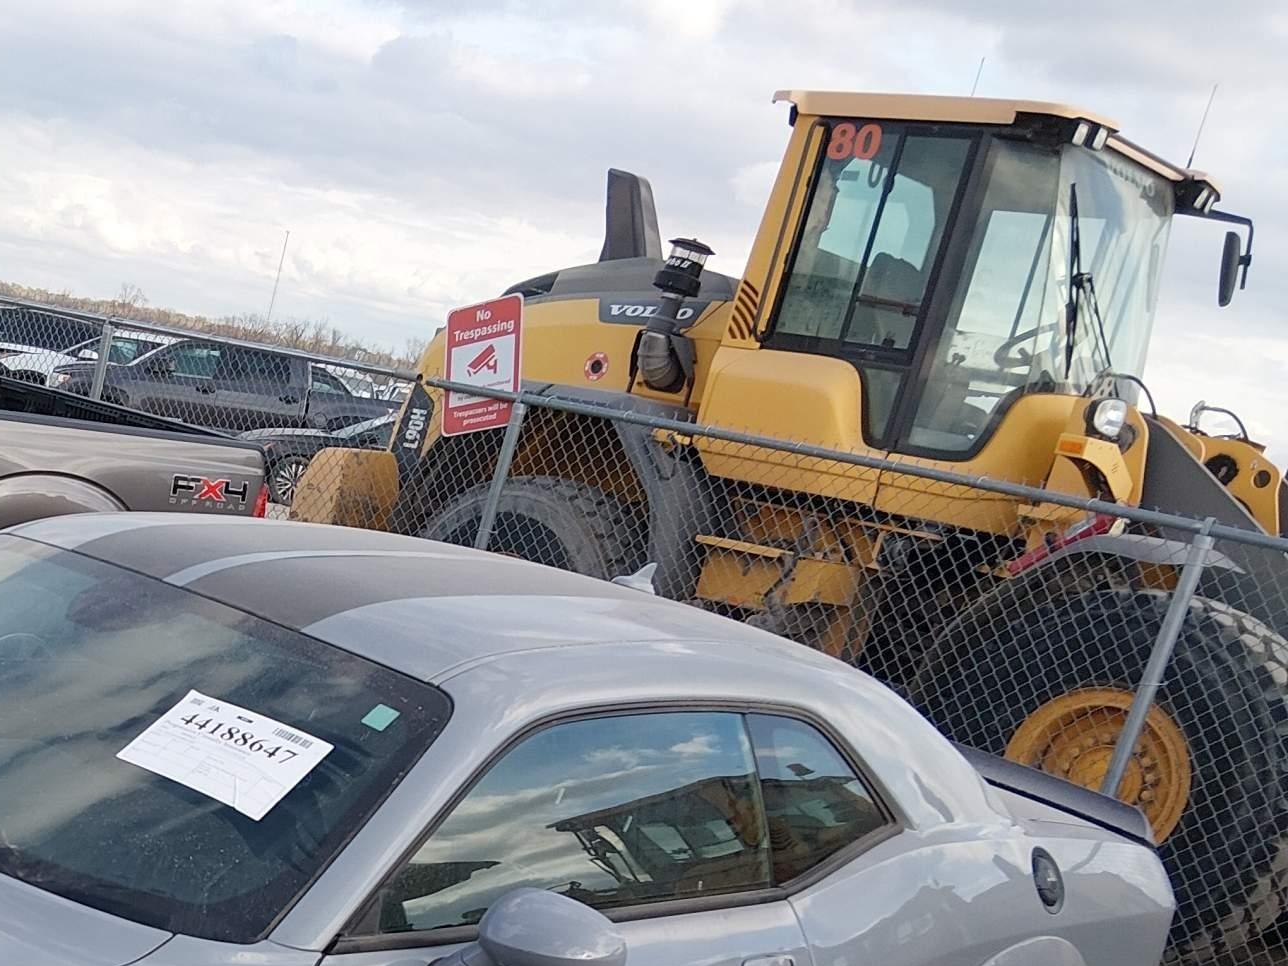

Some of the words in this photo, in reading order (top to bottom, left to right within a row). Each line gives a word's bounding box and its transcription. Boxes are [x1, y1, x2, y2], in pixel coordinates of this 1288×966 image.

[827, 123, 882, 160] 80
[476, 308, 492, 322] No
[609, 304, 694, 320] VOLO
[453, 320, 515, 342] Trespassing
[402, 408, 428, 449] L90H
[170, 473, 249, 504] FX4
[180, 713, 299, 764] 44188647
